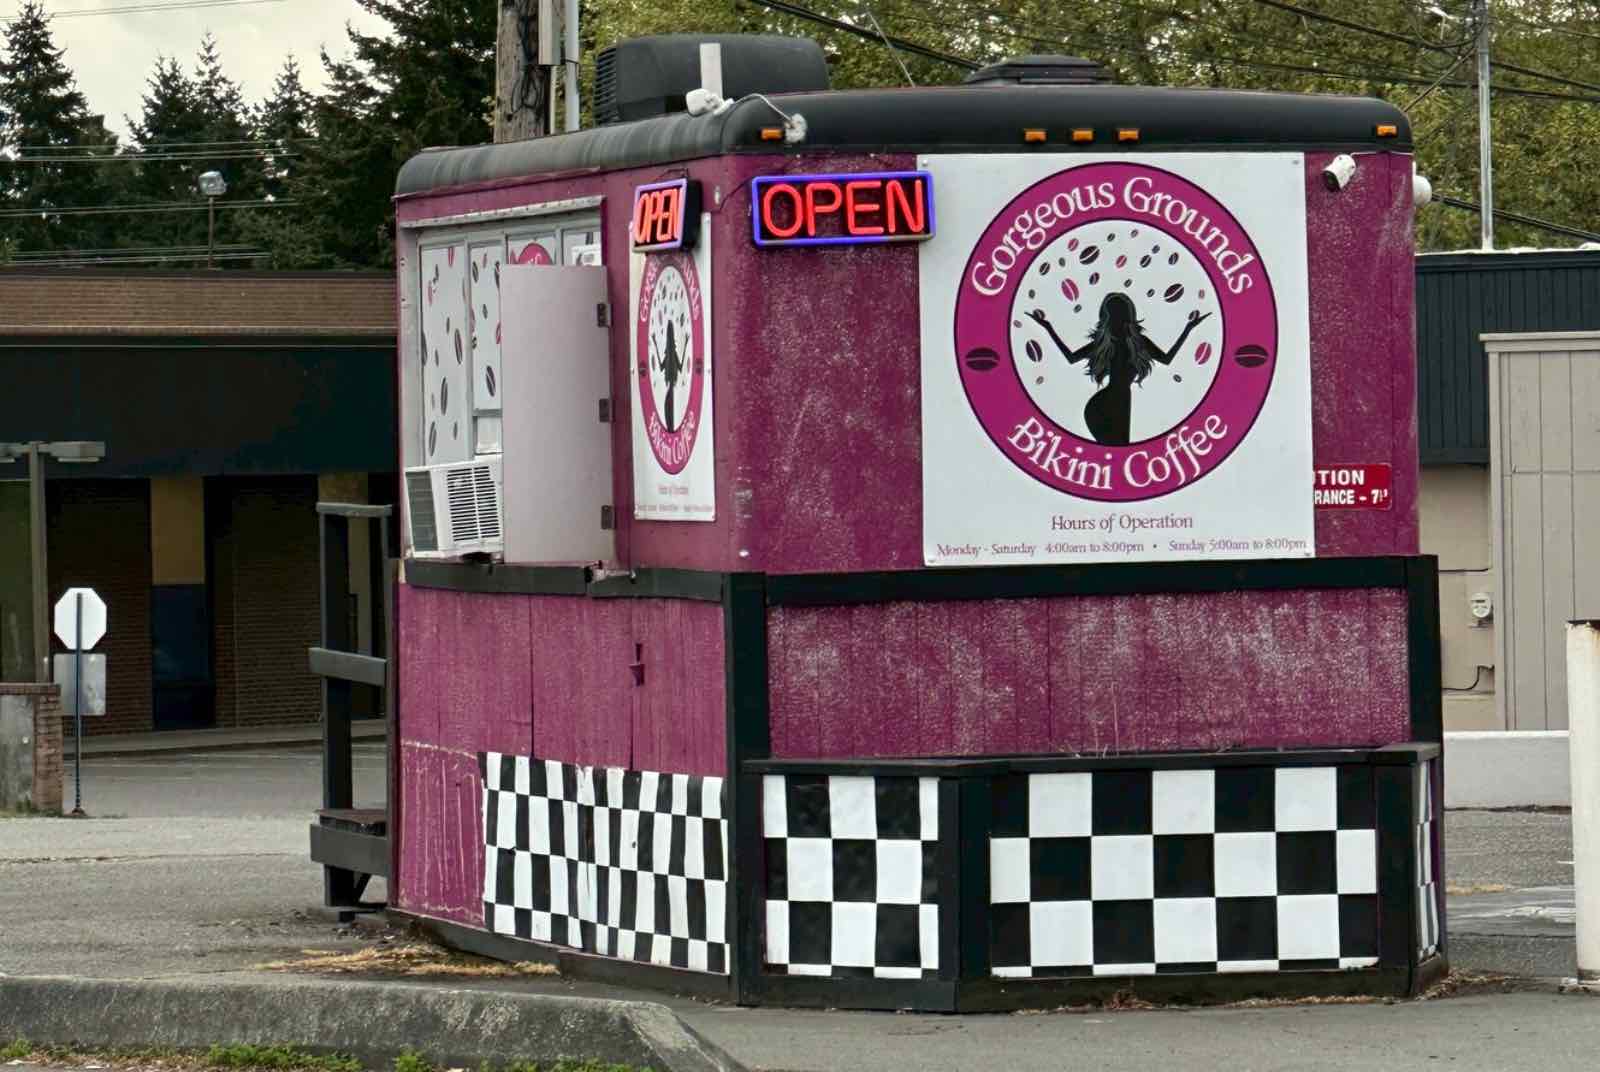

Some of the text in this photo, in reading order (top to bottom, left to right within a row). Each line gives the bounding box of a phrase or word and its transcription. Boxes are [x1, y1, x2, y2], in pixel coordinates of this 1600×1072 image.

[634, 188, 682, 244] OPEN
[763, 179, 925, 238] OPEN
[972, 176, 1256, 296] Gorgeous Grounds
[1006, 413, 1229, 490] Bikini Coffee
[1313, 469, 1365, 485] TION
[936, 543, 980, 558] Monday
[991, 542, 1036, 557] Saturday
[1045, 542, 1087, 553] 4:00am
[1089, 542, 1101, 553] to
[1102, 541, 1145, 555] 8:00pm
[1168, 539, 1206, 553] Sunday
[1208, 539, 1250, 552] 5:00am
[1252, 539, 1264, 550] to
[1265, 537, 1307, 551] 8:00pm
[1051, 512, 1193, 533] Hours of Operation
